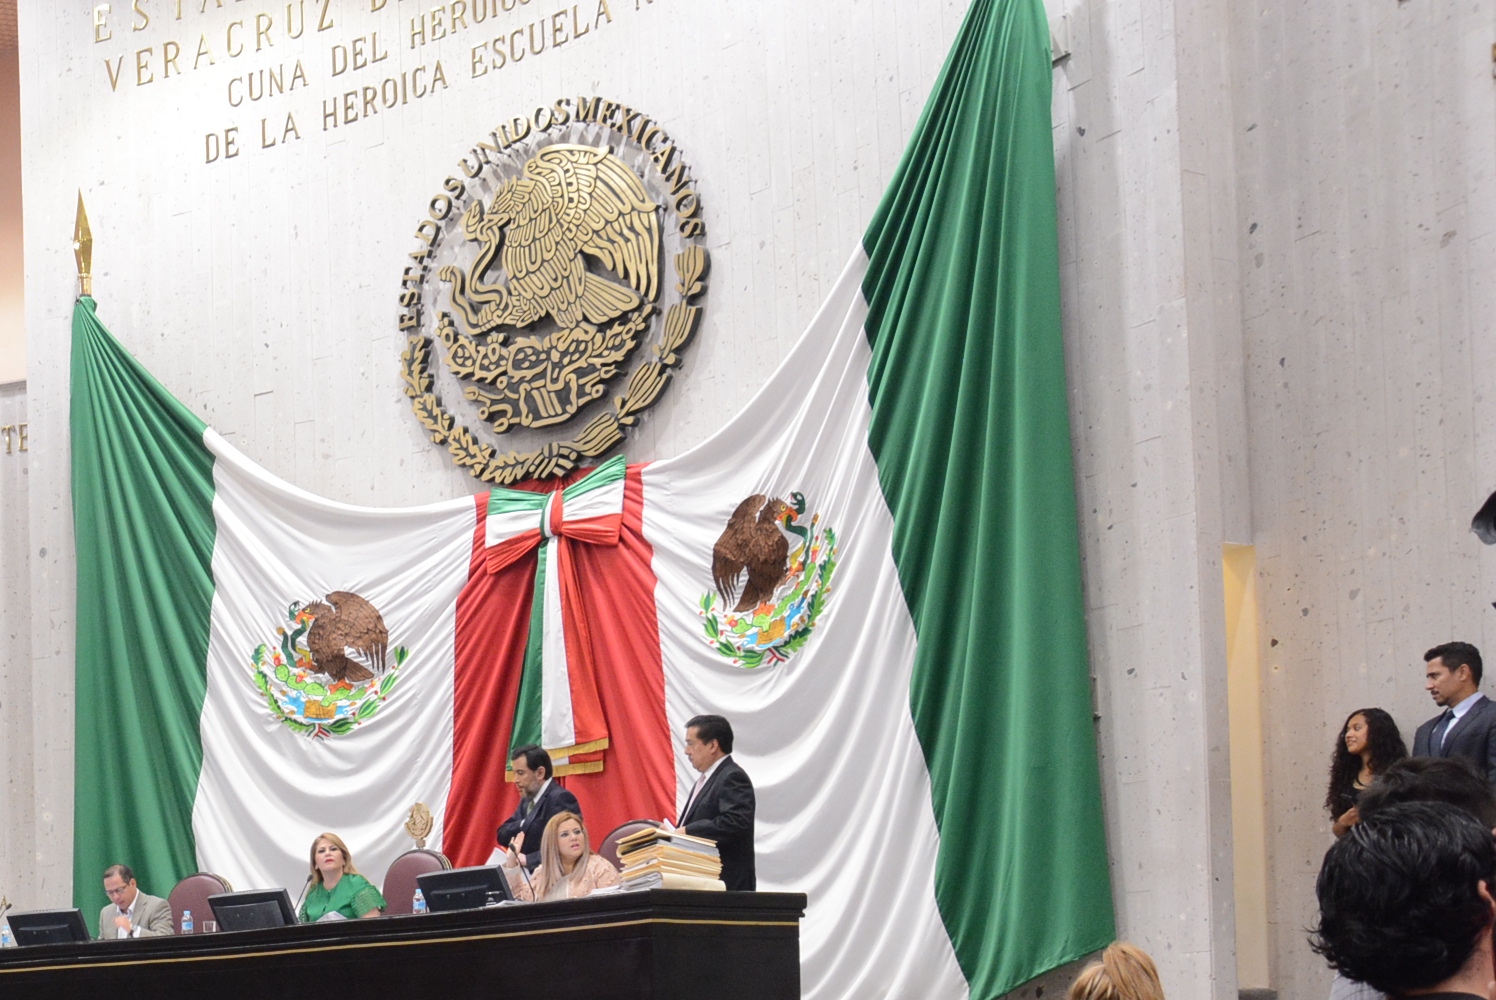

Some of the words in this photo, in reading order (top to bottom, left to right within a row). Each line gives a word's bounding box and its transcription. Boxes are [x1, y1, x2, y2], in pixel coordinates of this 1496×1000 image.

[104, 0, 334, 92] VERACRUZ
[205, 127, 240, 164] DE
[261, 112, 301, 149] LA
[322, 60, 448, 131] HEROICA
[471, 0, 612, 79] ESCUELA
[228, 59, 309, 107] CUNA
[331, 32, 388, 77] DEL
[398, 175, 466, 332] ESTADOS
[458, 98, 571, 179] UNIDOS
[573, 96, 708, 240] MEXICANOS
